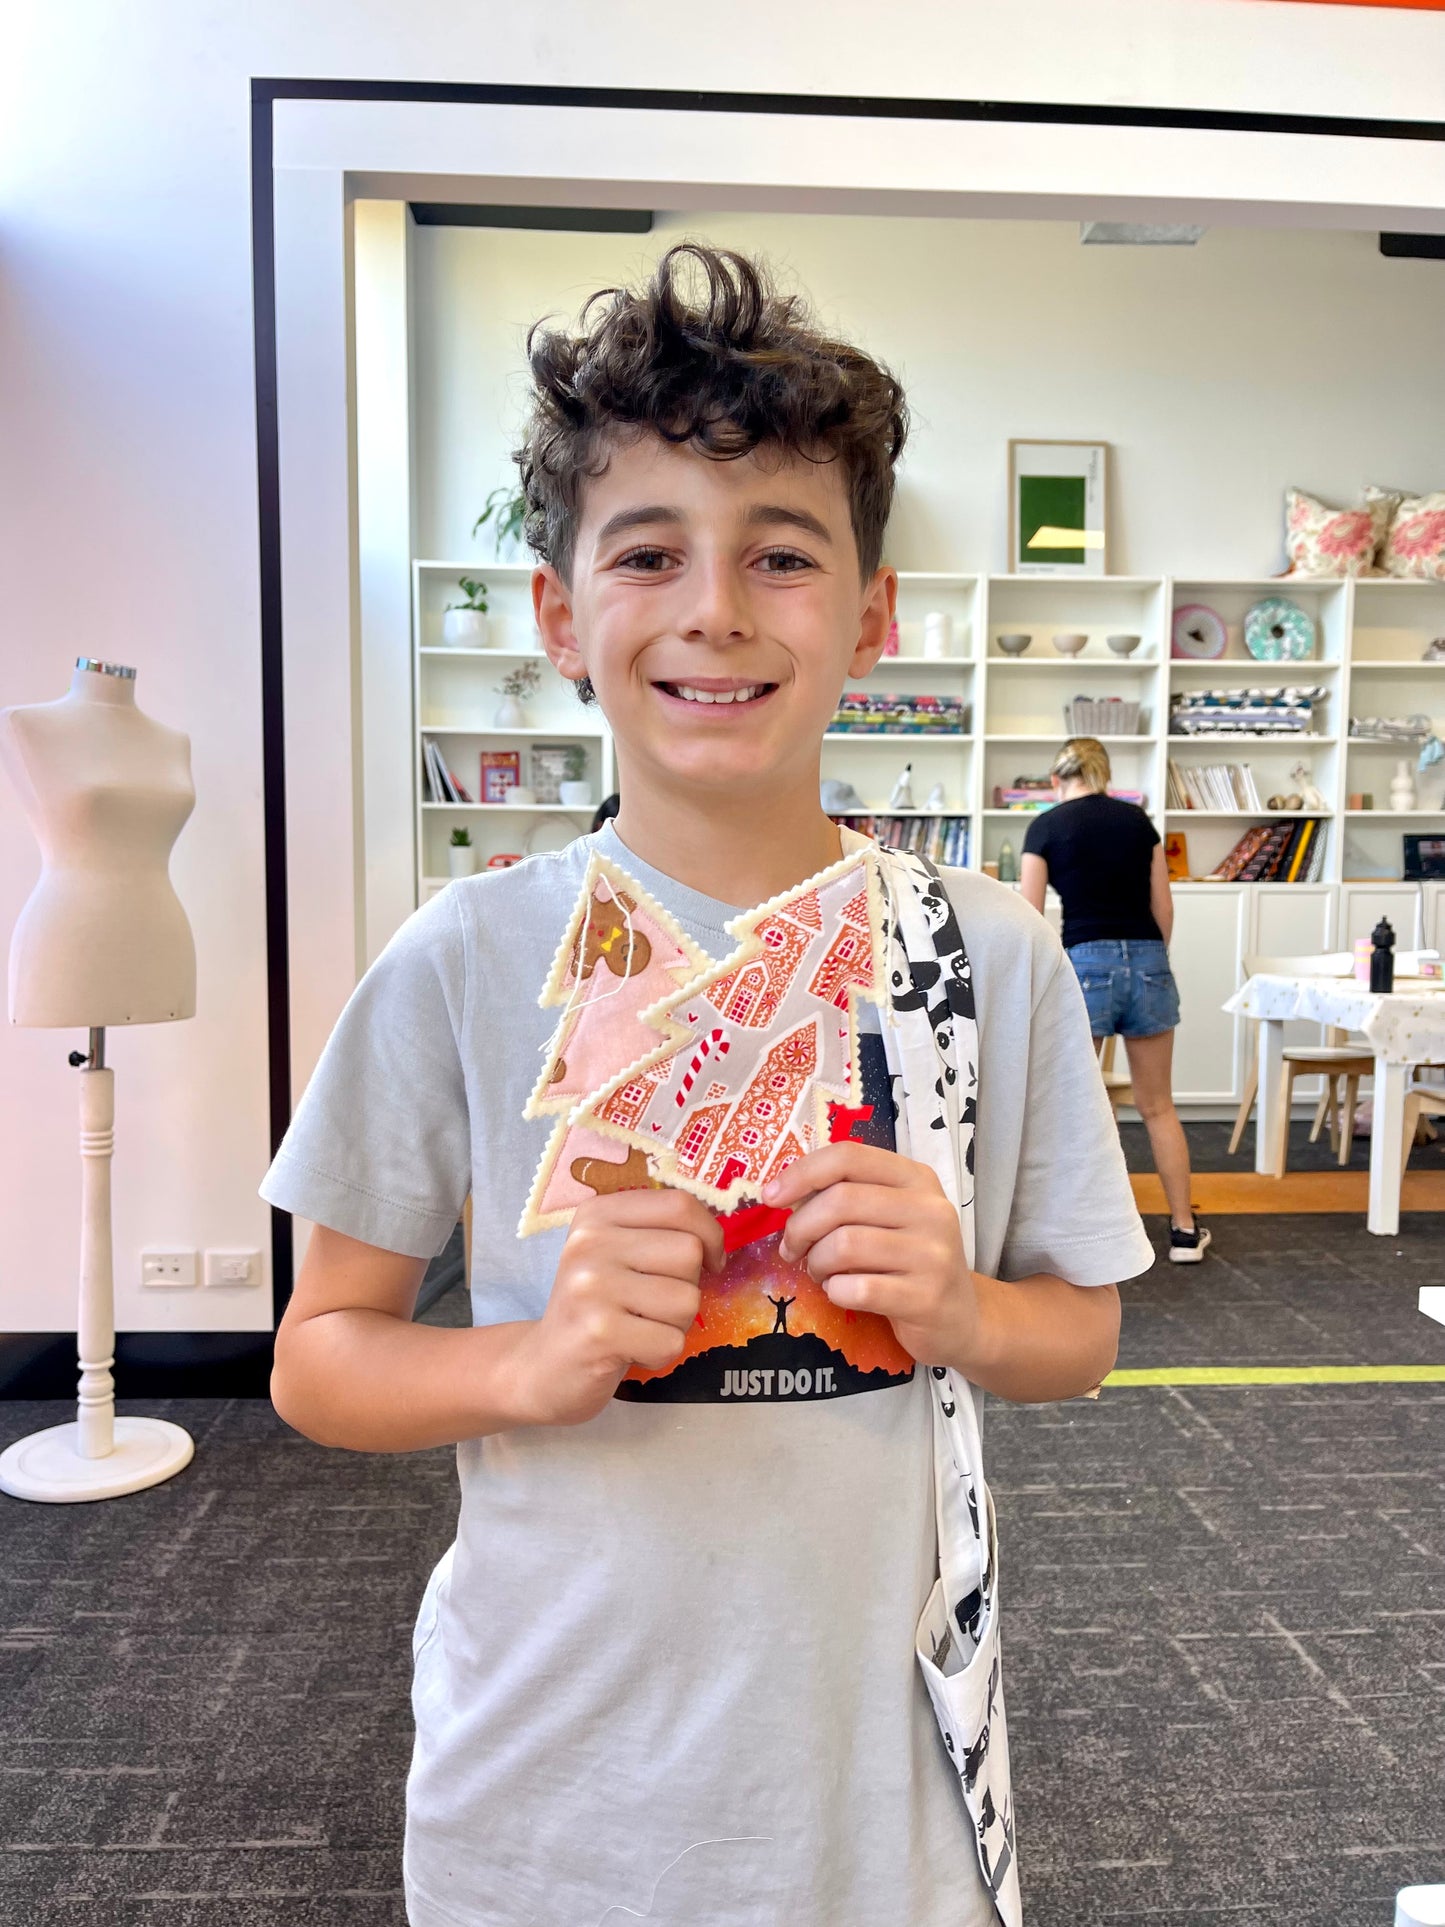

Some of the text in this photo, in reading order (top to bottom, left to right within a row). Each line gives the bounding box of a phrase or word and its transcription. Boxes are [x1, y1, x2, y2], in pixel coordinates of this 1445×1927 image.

[720, 1367, 837, 1396] JUST DO IT.
